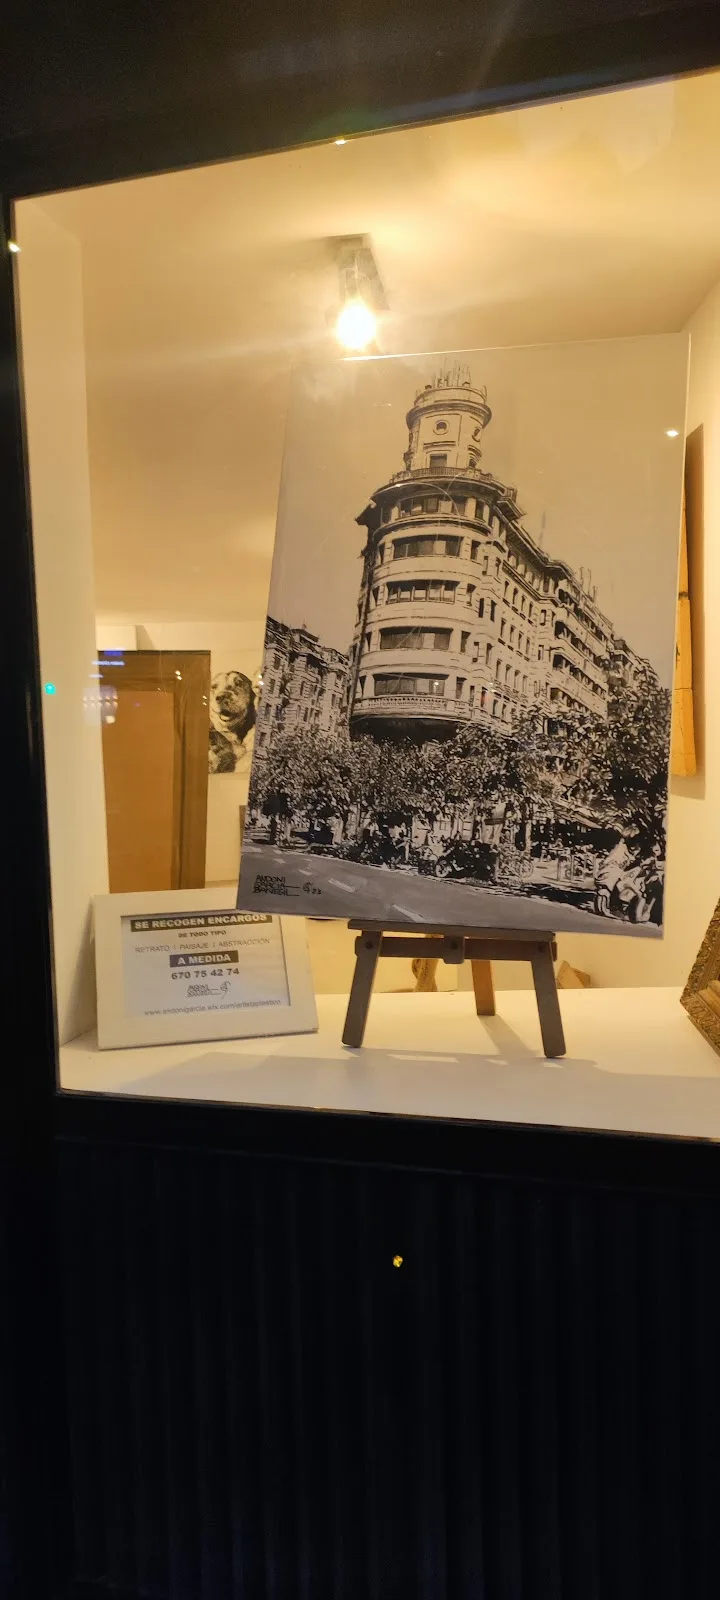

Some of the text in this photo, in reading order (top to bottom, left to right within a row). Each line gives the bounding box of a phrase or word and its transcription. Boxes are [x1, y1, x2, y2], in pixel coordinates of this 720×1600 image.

[134, 914, 268, 930] SE RECOGEN ENCARGOS
[134, 945, 171, 954] RETRATO
[179, 942, 209, 951] PAISAJE
[177, 953, 232, 966] A MEDIDA
[171, 967, 240, 980] 670 75 42 74
